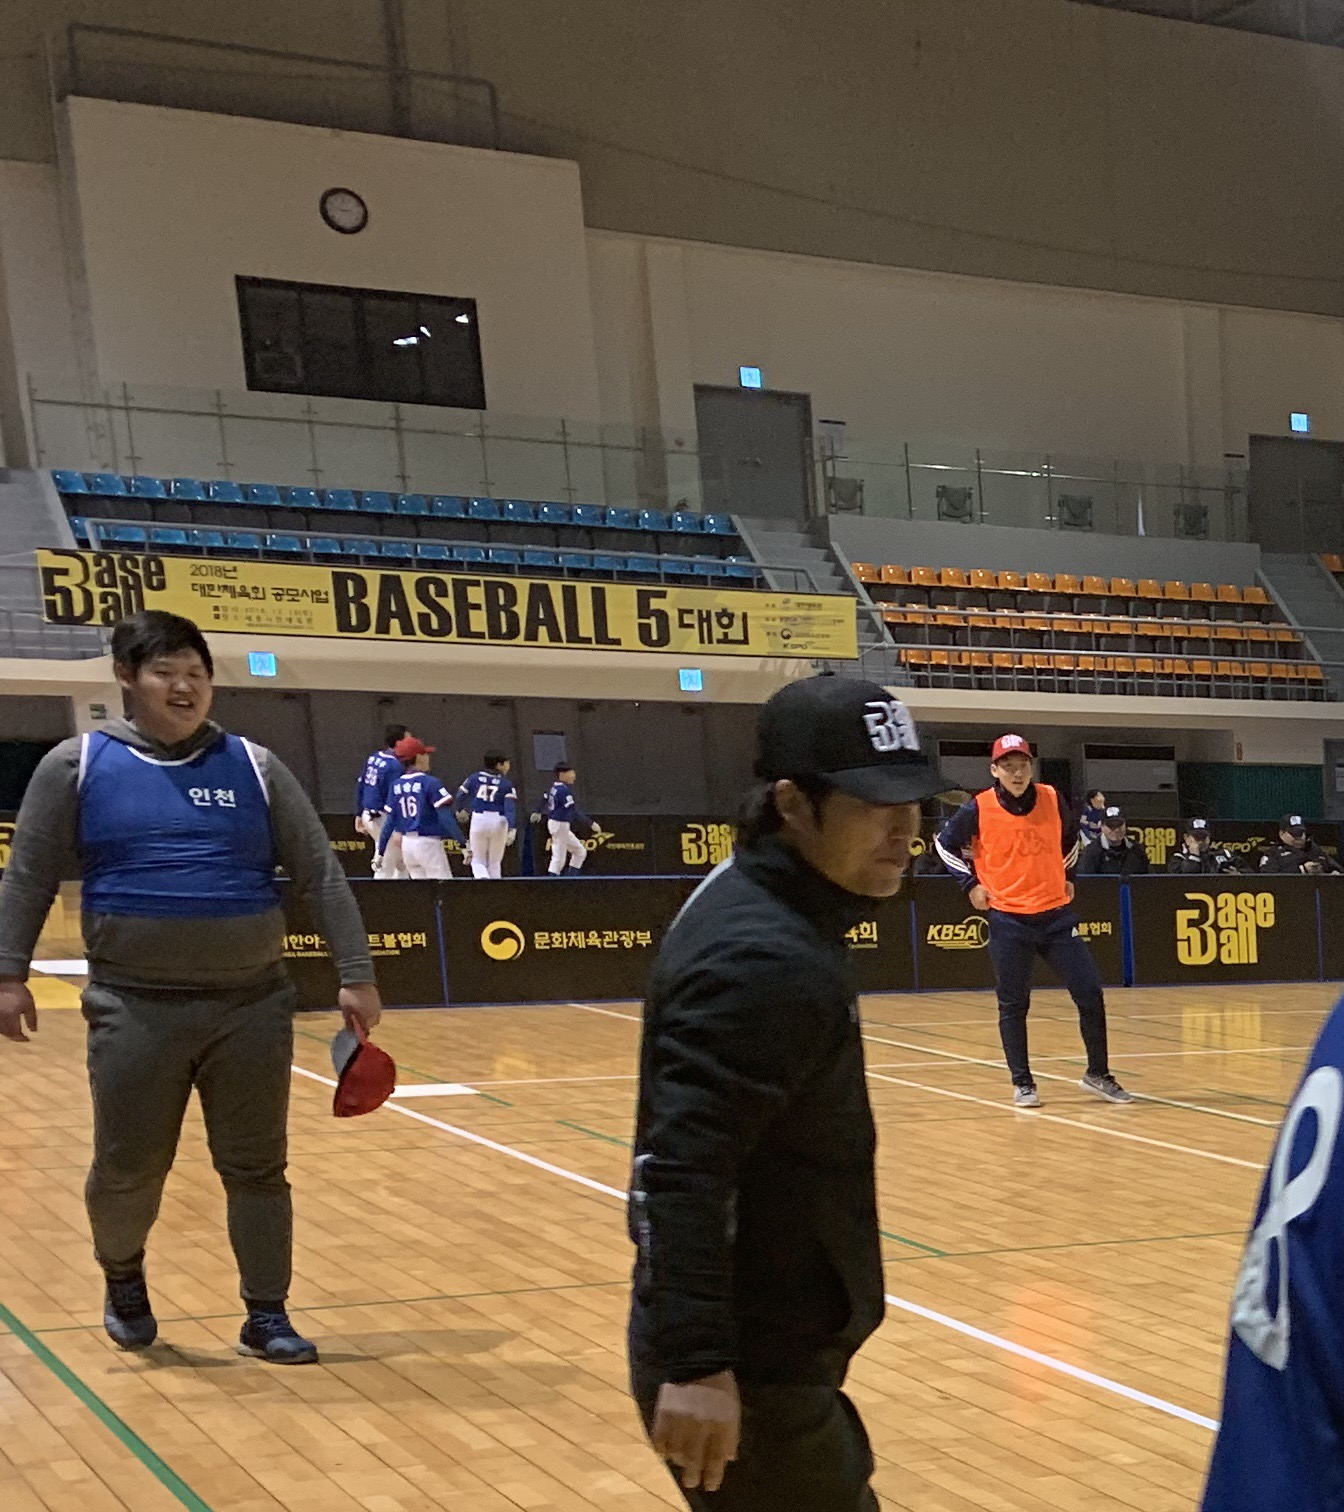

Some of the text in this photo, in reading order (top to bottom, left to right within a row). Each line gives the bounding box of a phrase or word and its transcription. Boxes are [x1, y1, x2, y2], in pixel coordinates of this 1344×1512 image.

[190, 564, 238, 580] 2018년
[331, 570, 622, 646] BASEBALL
[188, 787, 237, 808] 인천
[477, 783, 499, 802] 47
[399, 795, 418, 819] 16
[533, 930, 653, 950] 문화체육관광부
[926, 924, 979, 942] KBSA
[1230, 1065, 1344, 1372] 8
